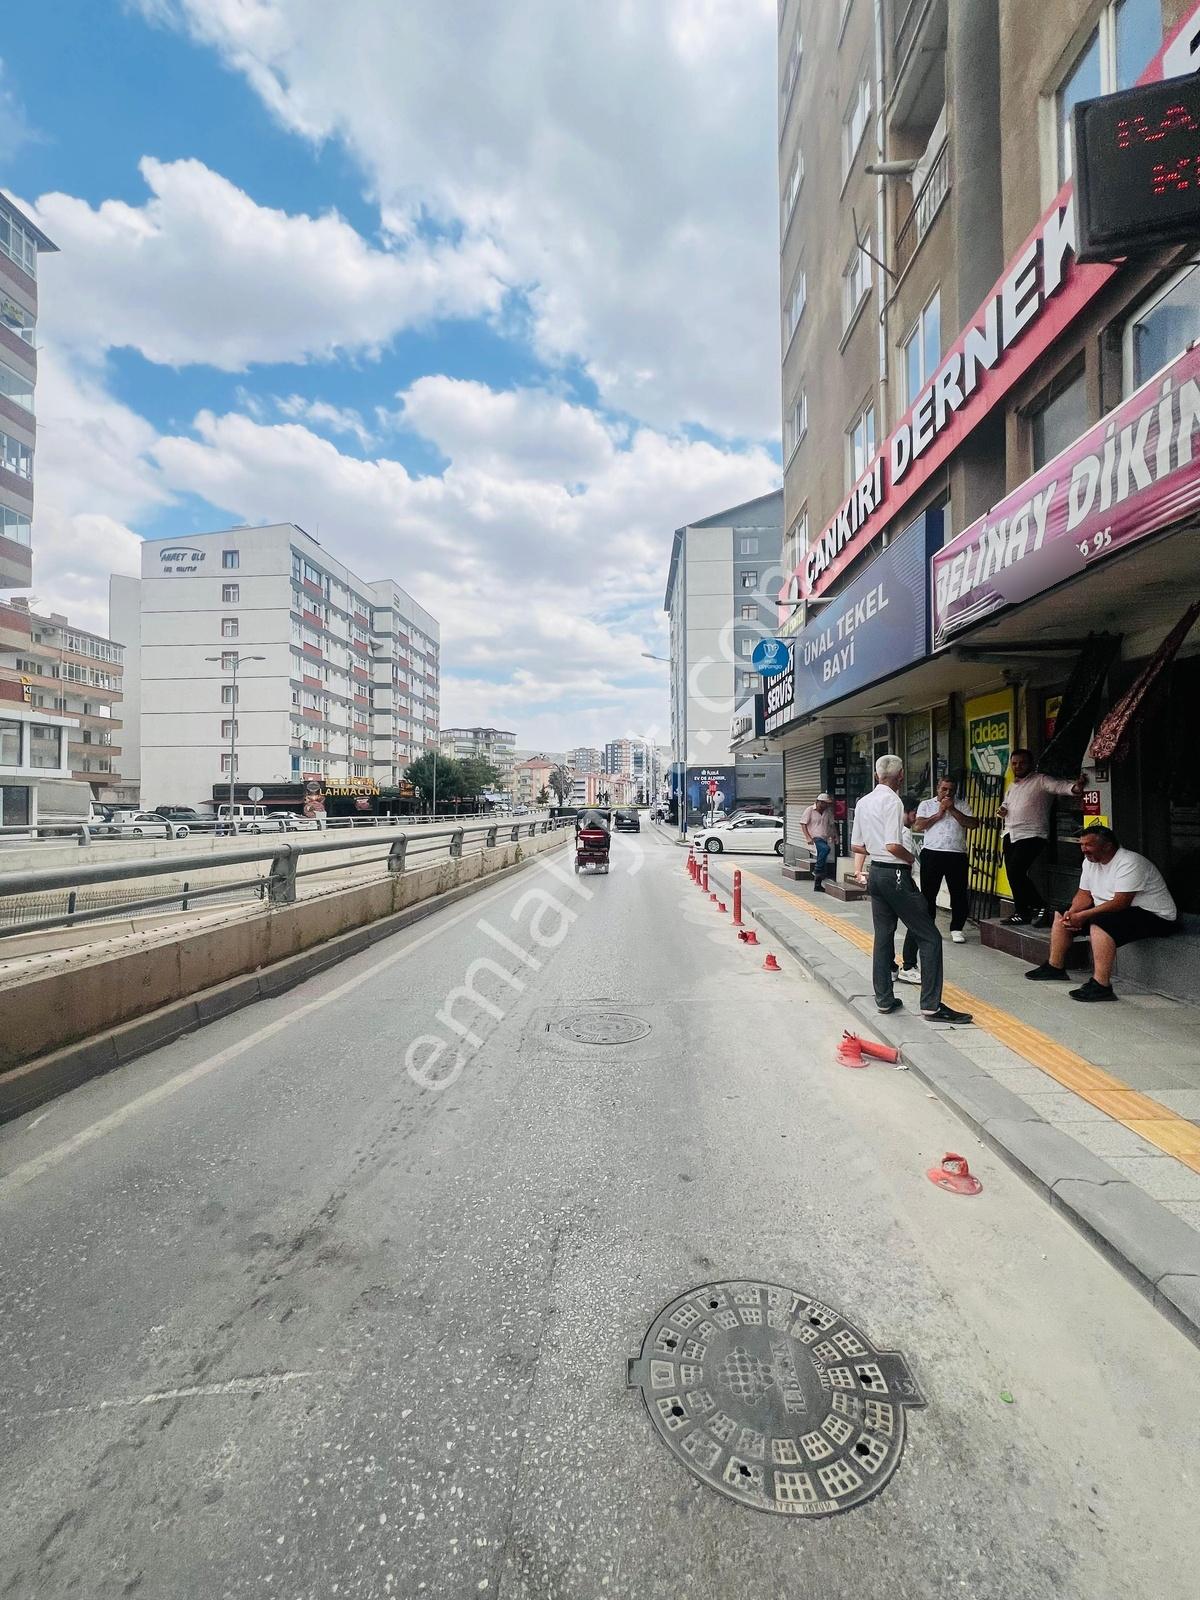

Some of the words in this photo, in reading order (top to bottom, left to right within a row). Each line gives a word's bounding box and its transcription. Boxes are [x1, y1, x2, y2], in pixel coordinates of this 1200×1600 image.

[805, 456, 882, 595] ÇANKIRI
[1093, 526, 1113, 550] 95
[803, 627, 835, 667] ÜNAL
[836, 581, 889, 641] TEKEL
[823, 635, 856, 682] BAYİ
[767, 674, 793, 714] SERVİS
[972, 720, 1007, 744] iddaa
[320, 787, 380, 796] LAHMACUN
[1083, 791, 1098, 804] +18
